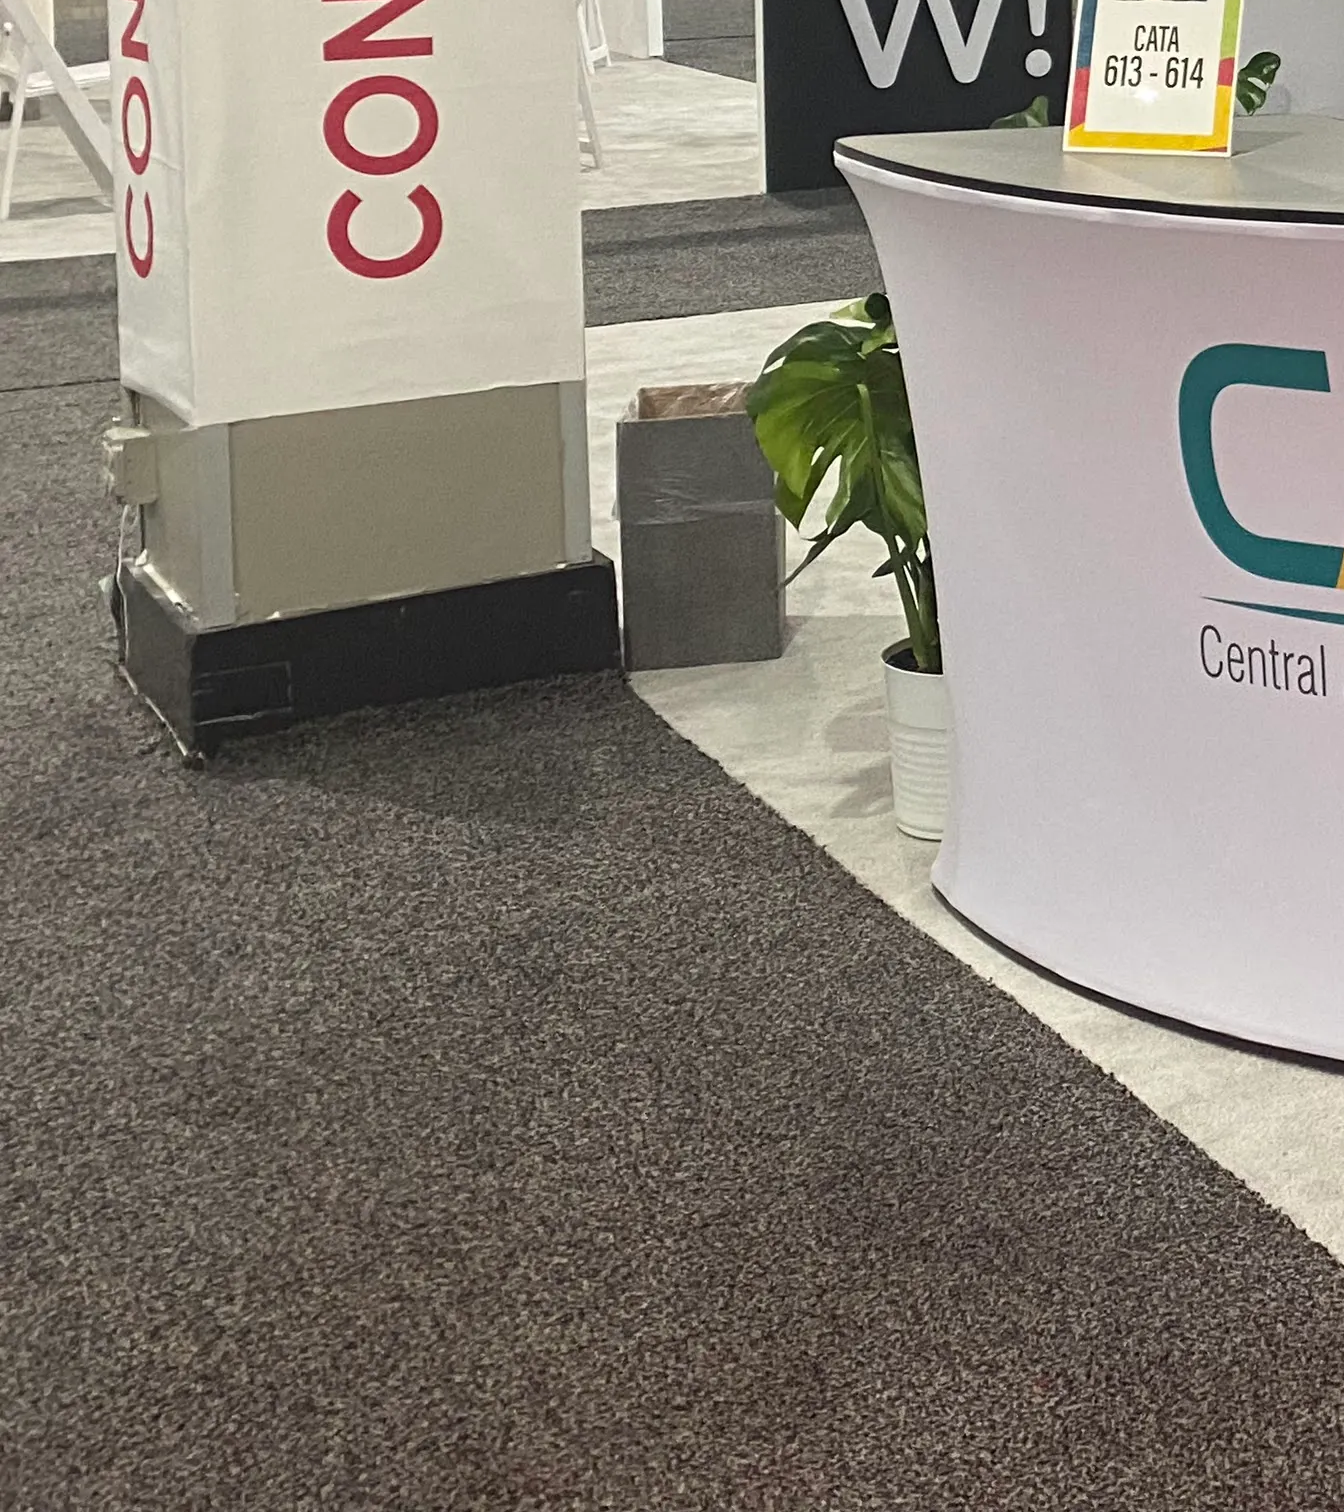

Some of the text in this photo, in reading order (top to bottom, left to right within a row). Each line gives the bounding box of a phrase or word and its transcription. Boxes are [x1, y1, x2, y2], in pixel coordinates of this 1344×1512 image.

[1134, 25, 1180, 52] CATA
[1104, 55, 1142, 87] 613
[1165, 57, 1204, 89] 614
[1200, 625, 1327, 696] Central
